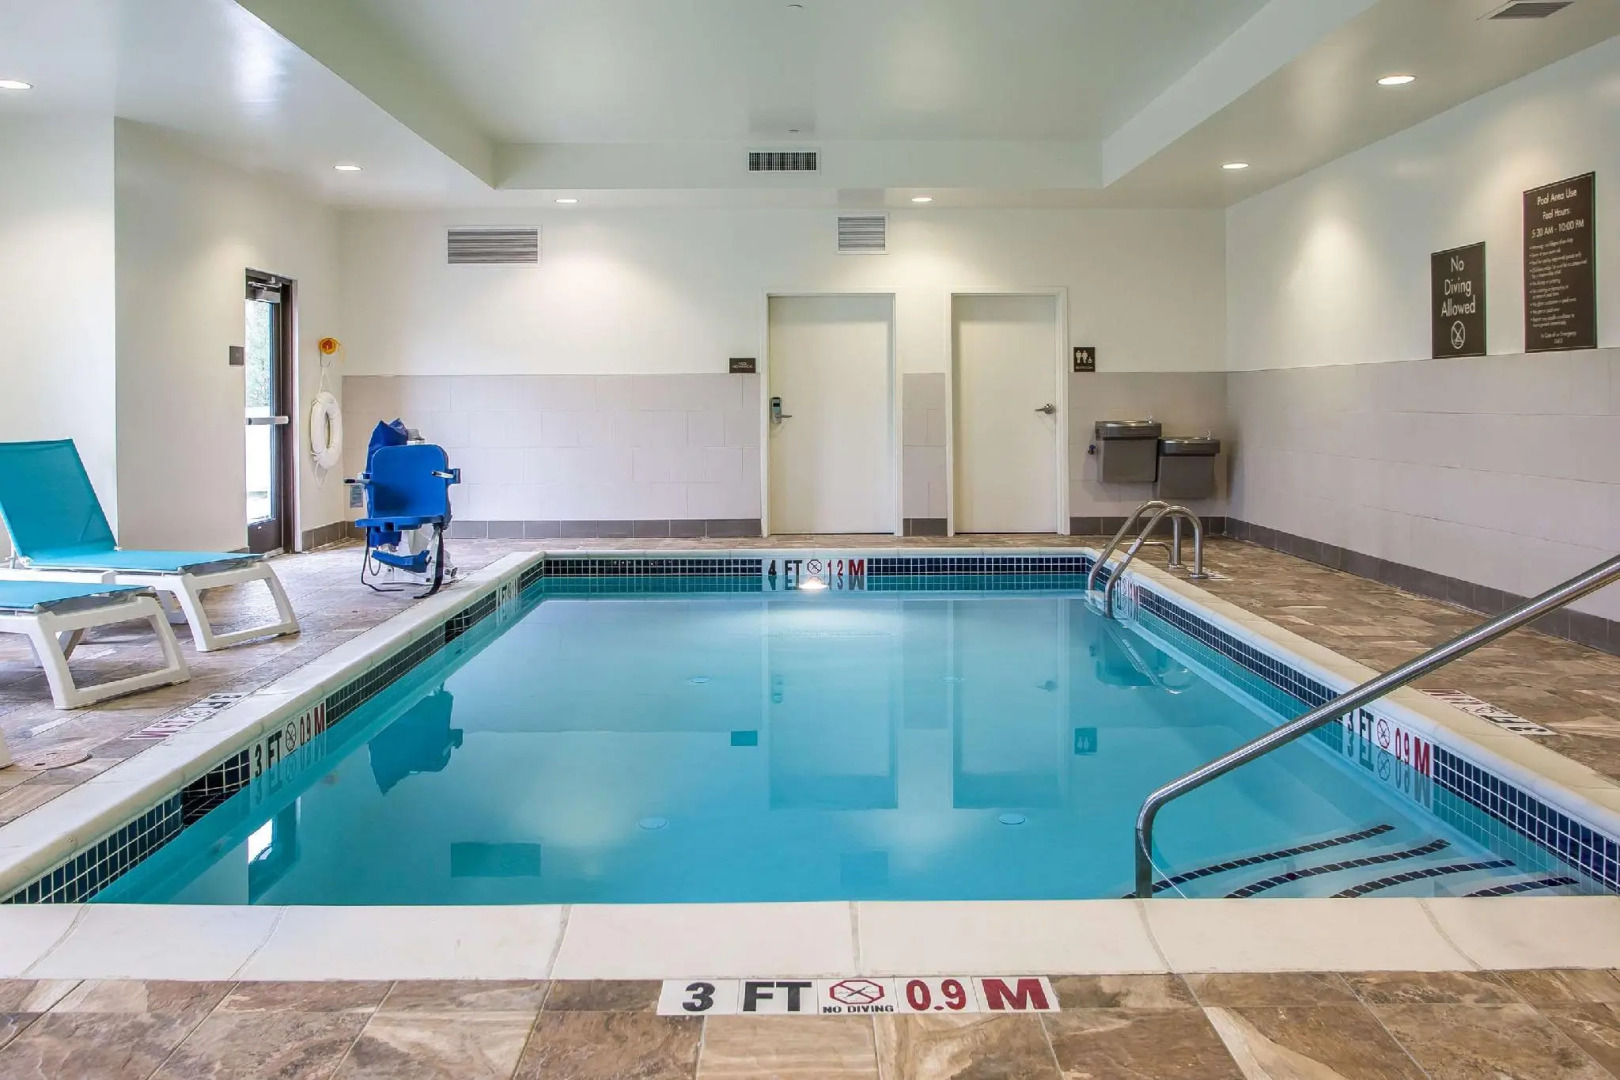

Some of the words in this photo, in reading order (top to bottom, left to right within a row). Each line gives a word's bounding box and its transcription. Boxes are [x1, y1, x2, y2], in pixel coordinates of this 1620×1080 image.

[1537, 193, 1549, 206] Pool
[1550, 193, 1564, 202] Area
[1566, 188, 1577, 198] Use
[1544, 226, 1553, 235] AM
[1575, 219, 1585, 229] PM
[1450, 255, 1465, 272] No
[1444, 277, 1472, 297] Diving
[1441, 294, 1476, 317] Allowed
[768, 560, 777, 576] 4
[784, 559, 802, 576] FT
[848, 559, 864, 576] M
[255, 743, 262, 778] 3
[267, 730, 282, 769] FT
[313, 702, 325, 737] M
[1359, 708, 1374, 742] FT
[1414, 736, 1430, 778] M
[682, 981, 716, 1012] 3
[742, 981, 812, 1012] FT
[906, 979, 966, 1011] 0.9
[981, 979, 1051, 1010] M
[847, 1005, 894, 1013] DIVING
